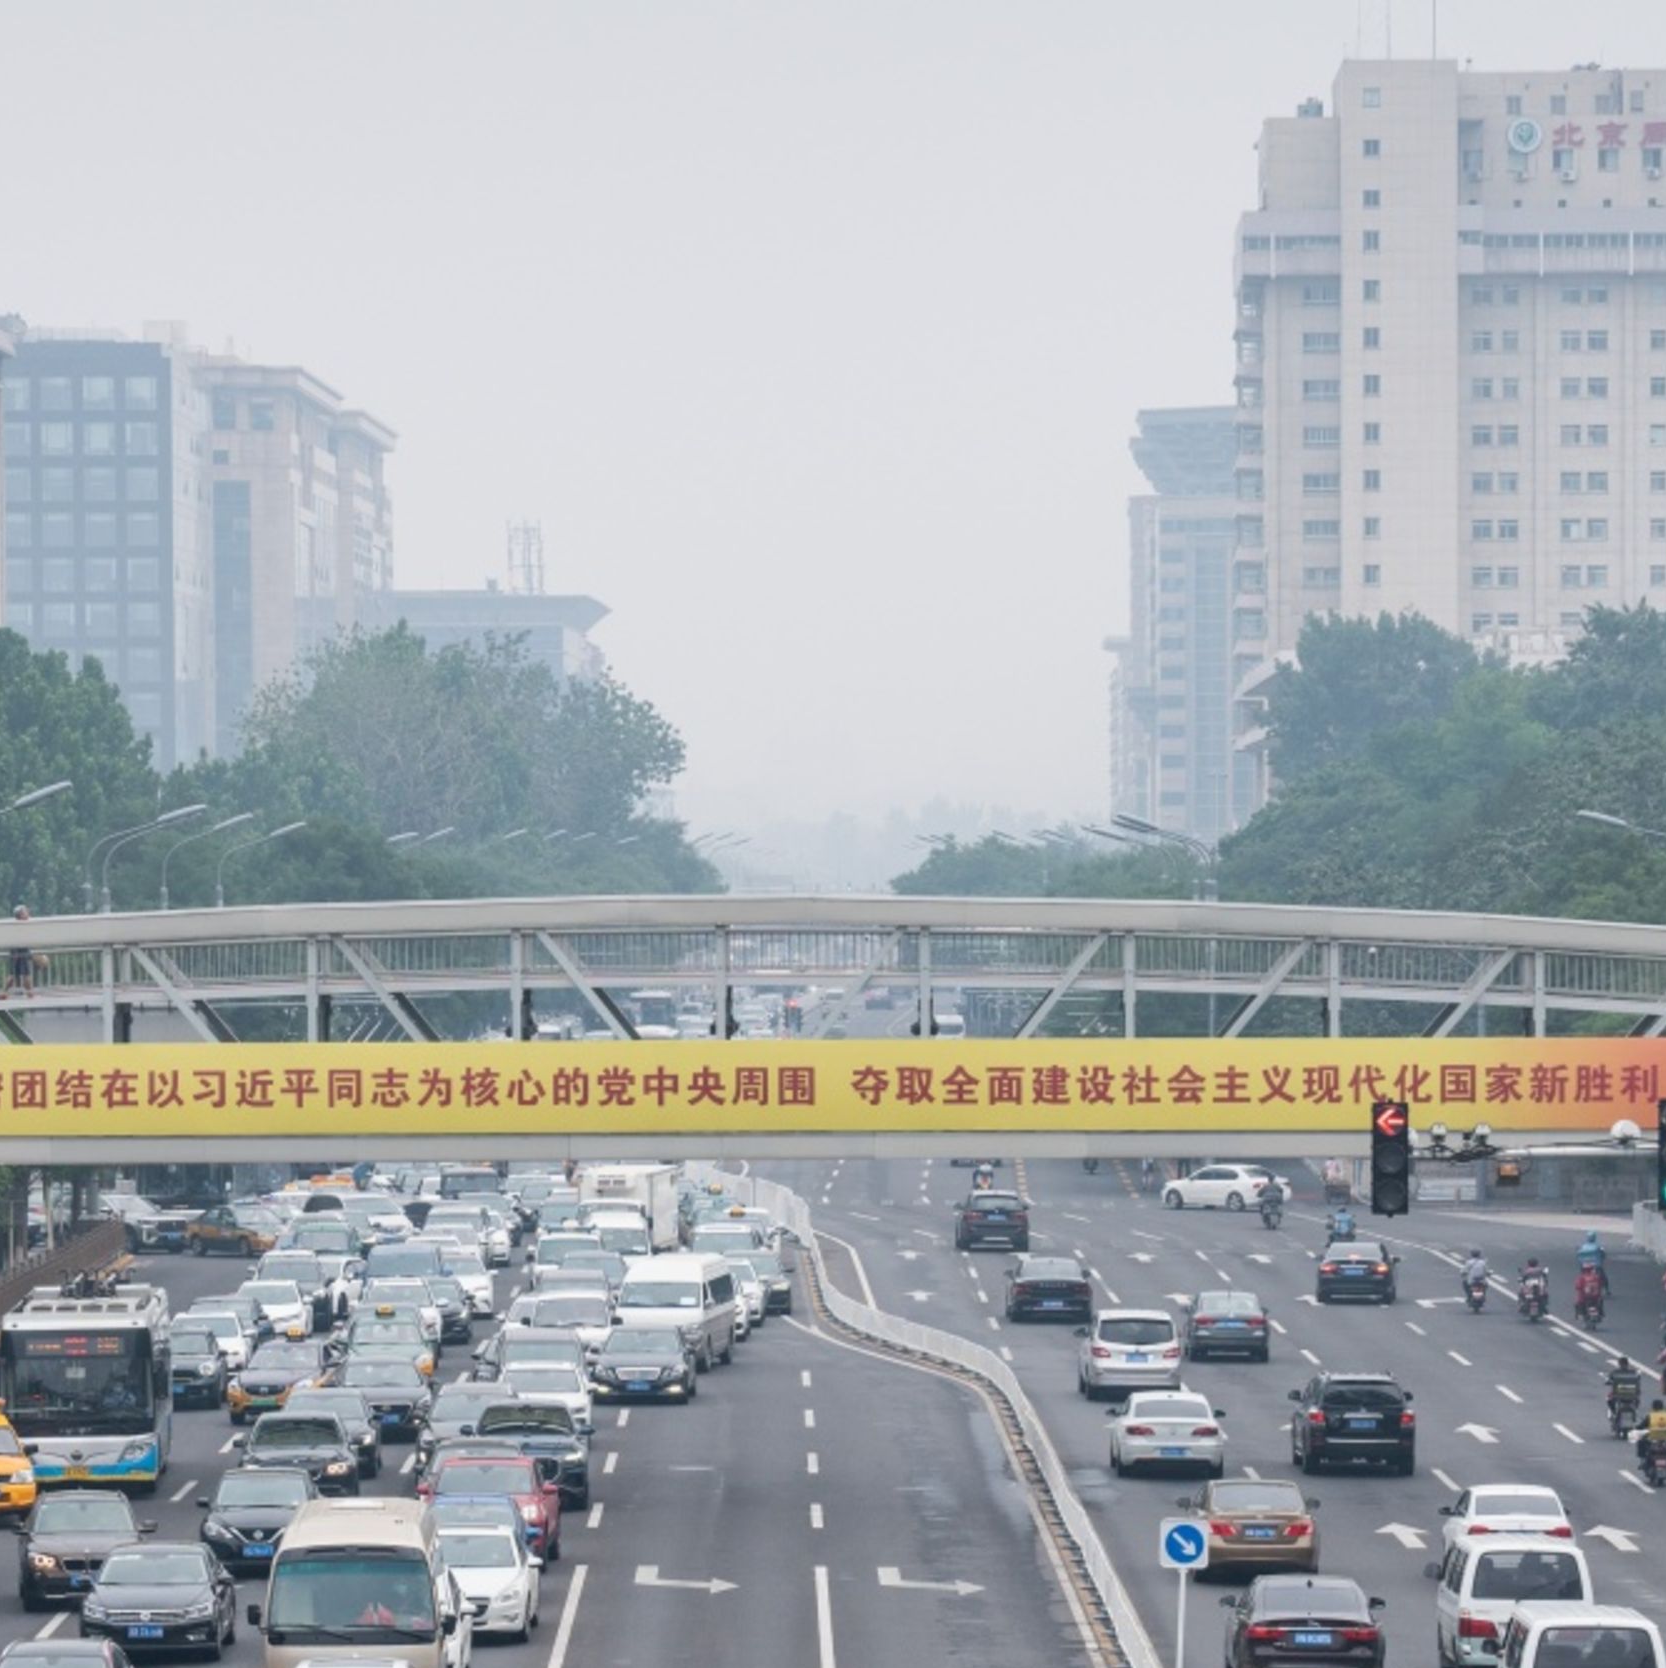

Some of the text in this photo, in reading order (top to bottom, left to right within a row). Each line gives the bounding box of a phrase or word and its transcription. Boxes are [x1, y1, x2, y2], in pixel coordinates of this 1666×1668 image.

[852, 1061, 1661, 1107] 夺取全面建设社会主义现代化国家新胜利
